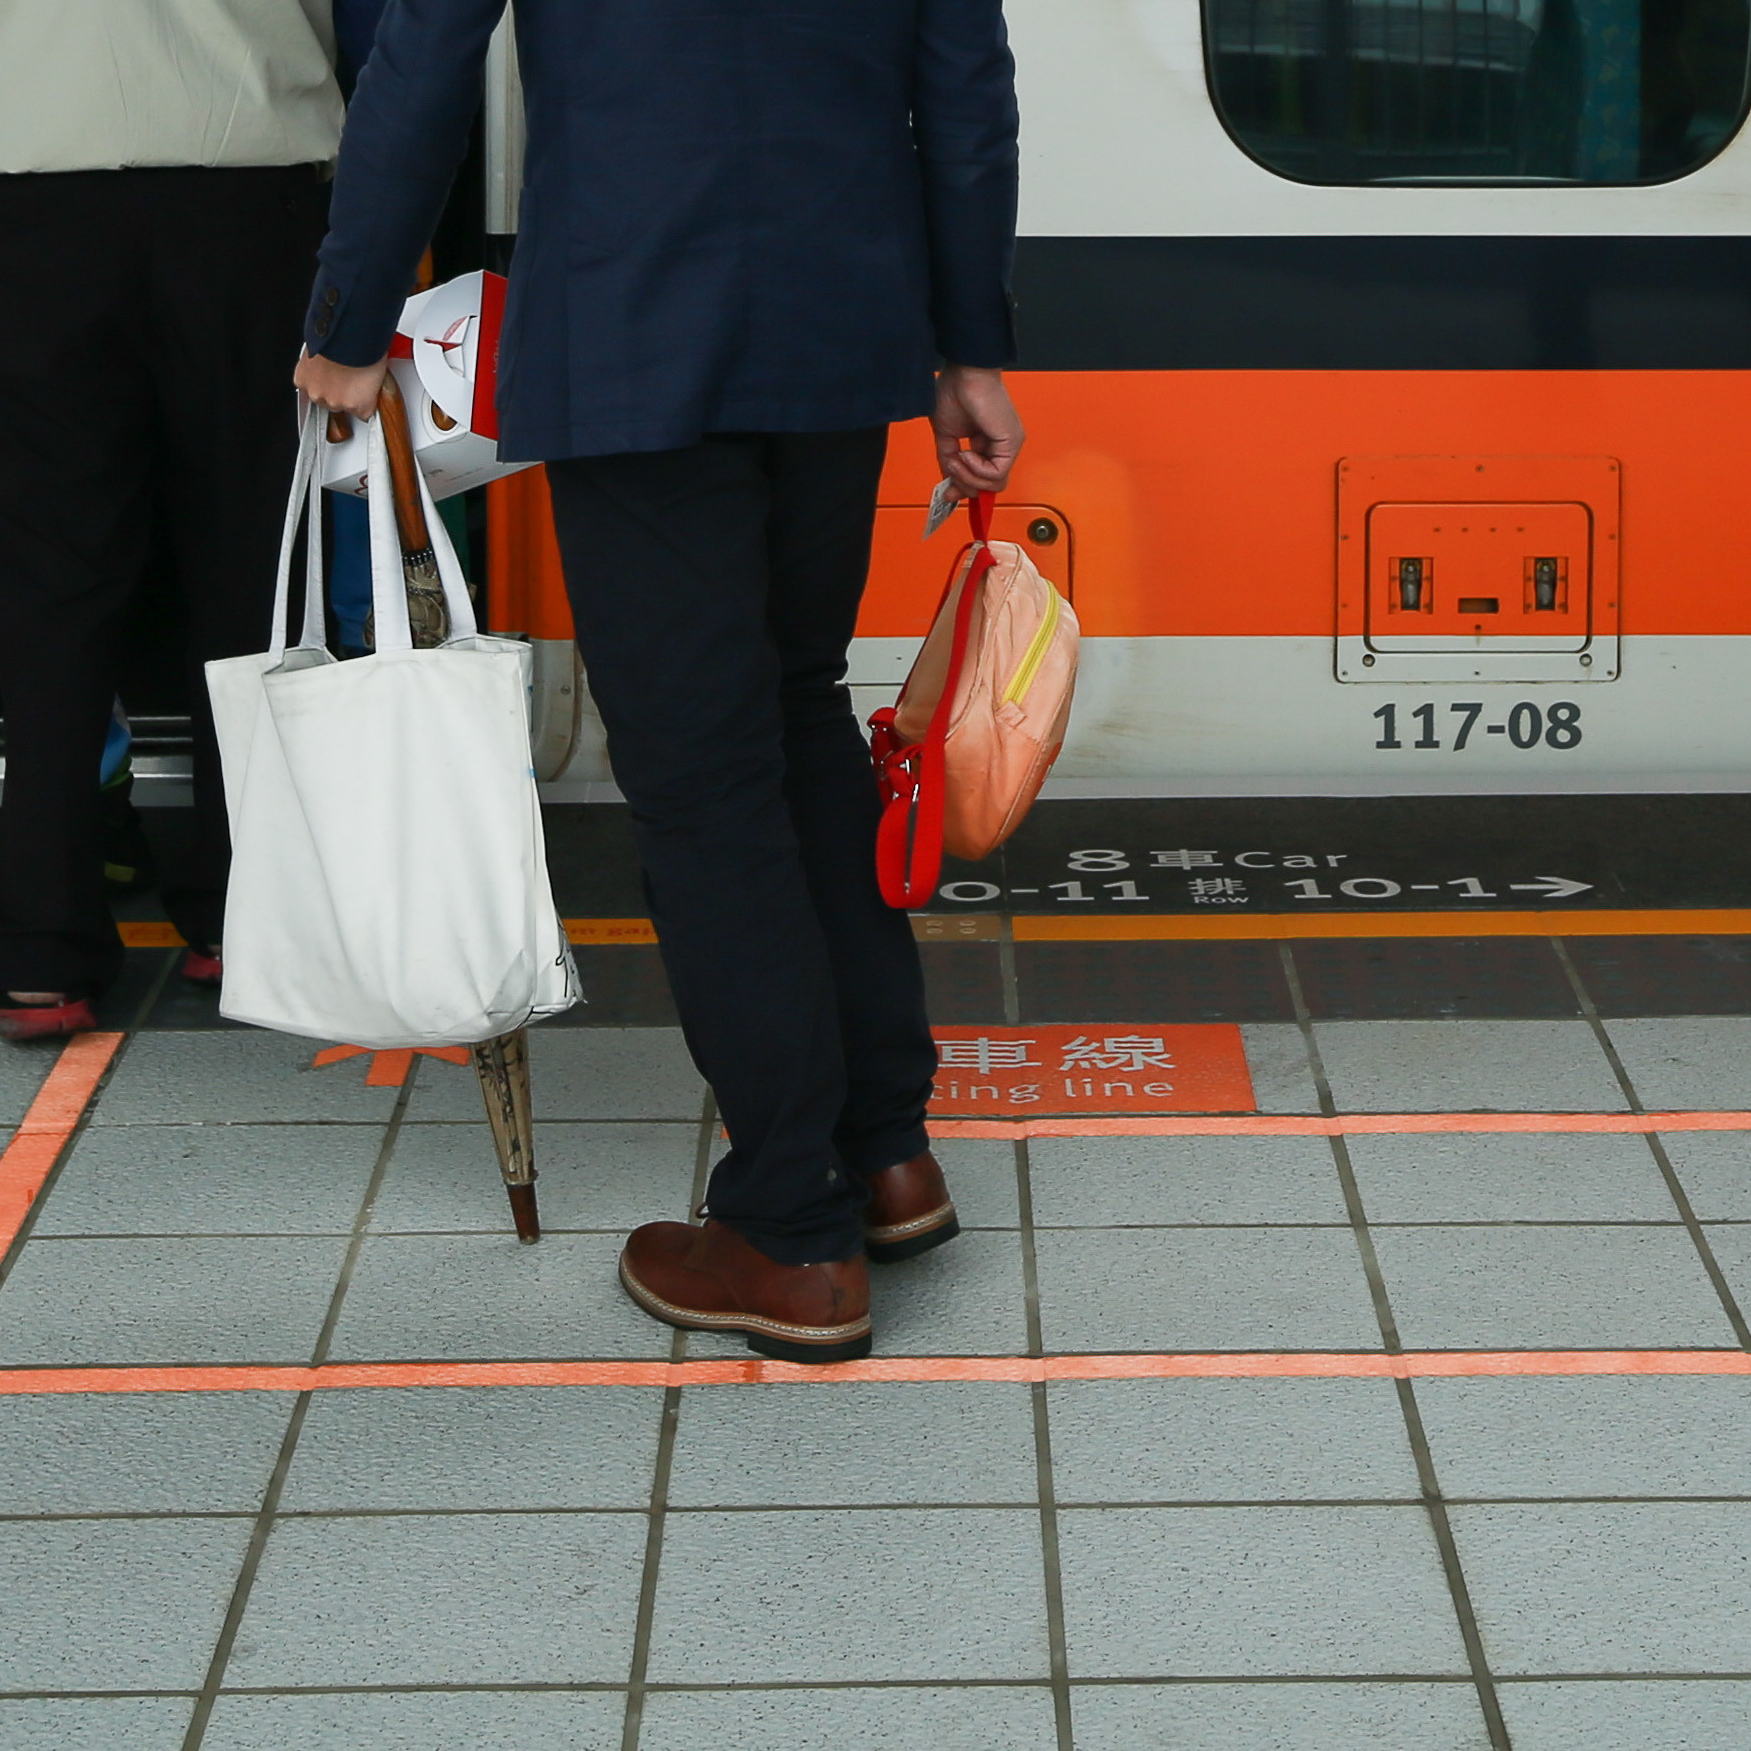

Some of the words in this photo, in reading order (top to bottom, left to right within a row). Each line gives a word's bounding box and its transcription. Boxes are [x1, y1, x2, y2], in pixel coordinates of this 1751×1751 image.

[1372, 700, 1584, 752] 117-08
[1234, 851, 1348, 869] Car
[1283, 877, 1498, 900] 10-1
[1194, 896, 1249, 905] Row
[1064, 1078, 1174, 1098] line
